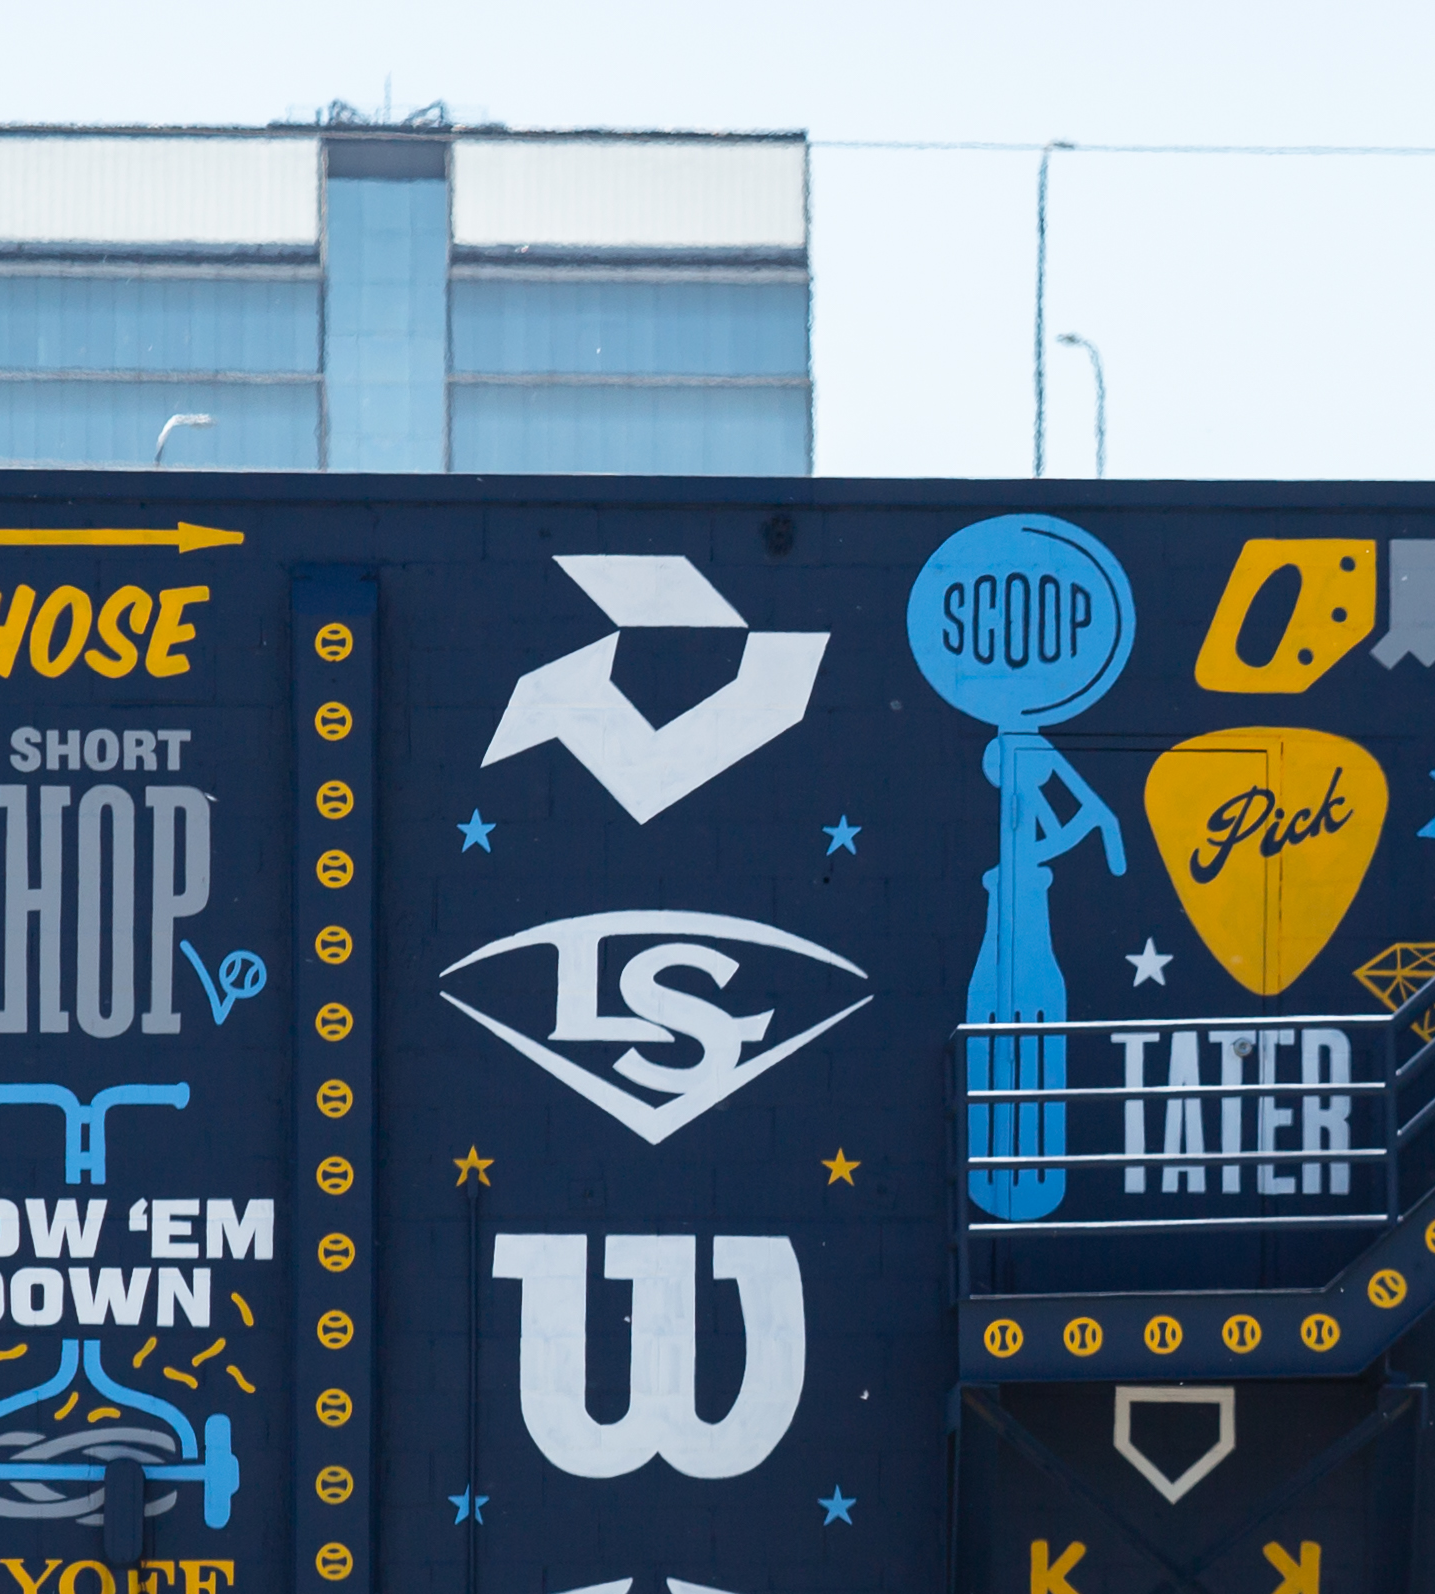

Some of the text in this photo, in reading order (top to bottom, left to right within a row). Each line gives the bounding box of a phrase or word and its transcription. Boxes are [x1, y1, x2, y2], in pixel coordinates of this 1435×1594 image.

[942, 571, 1091, 669] SCOOP
[9, 727, 191, 772] SHORT
[1189, 767, 1353, 884] Pick
[1110, 1027, 1352, 1197] TATER
[128, 1198, 274, 1260] 'EM
